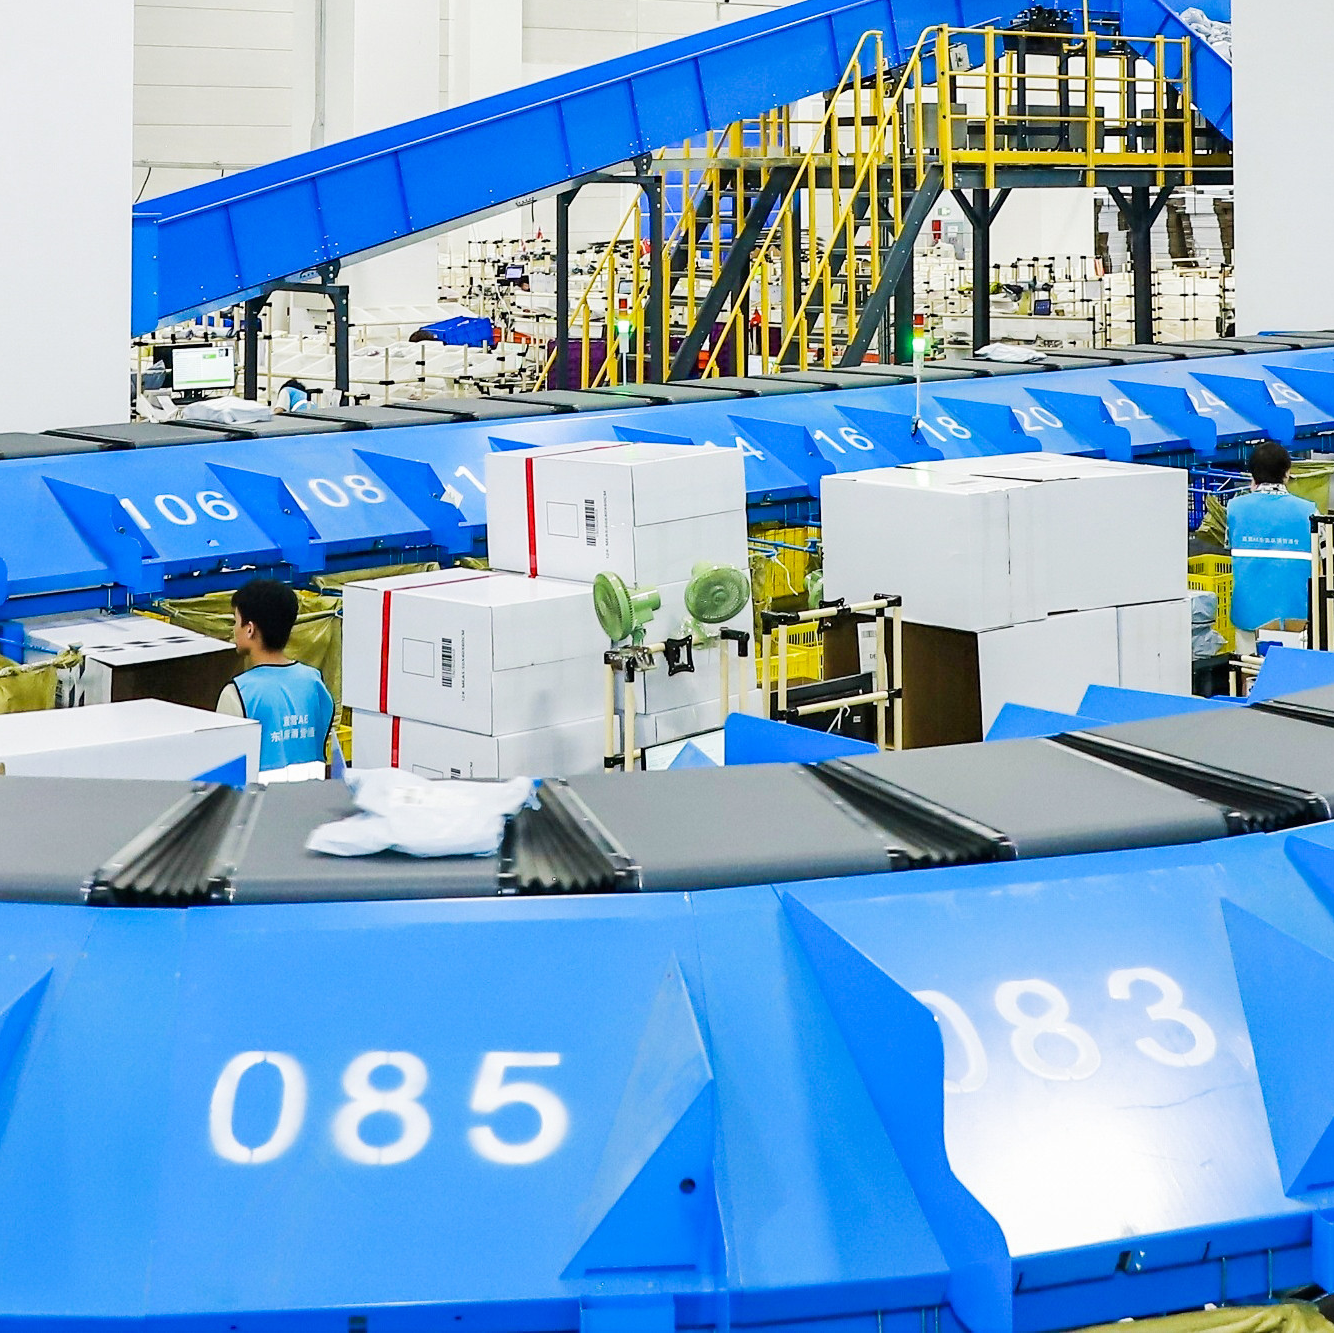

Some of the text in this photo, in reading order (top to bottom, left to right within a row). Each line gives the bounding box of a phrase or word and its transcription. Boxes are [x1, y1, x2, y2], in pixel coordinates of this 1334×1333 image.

[814, 427, 874, 454] 16
[110, 490, 238, 530] 106
[208, 1050, 568, 1165] 085
